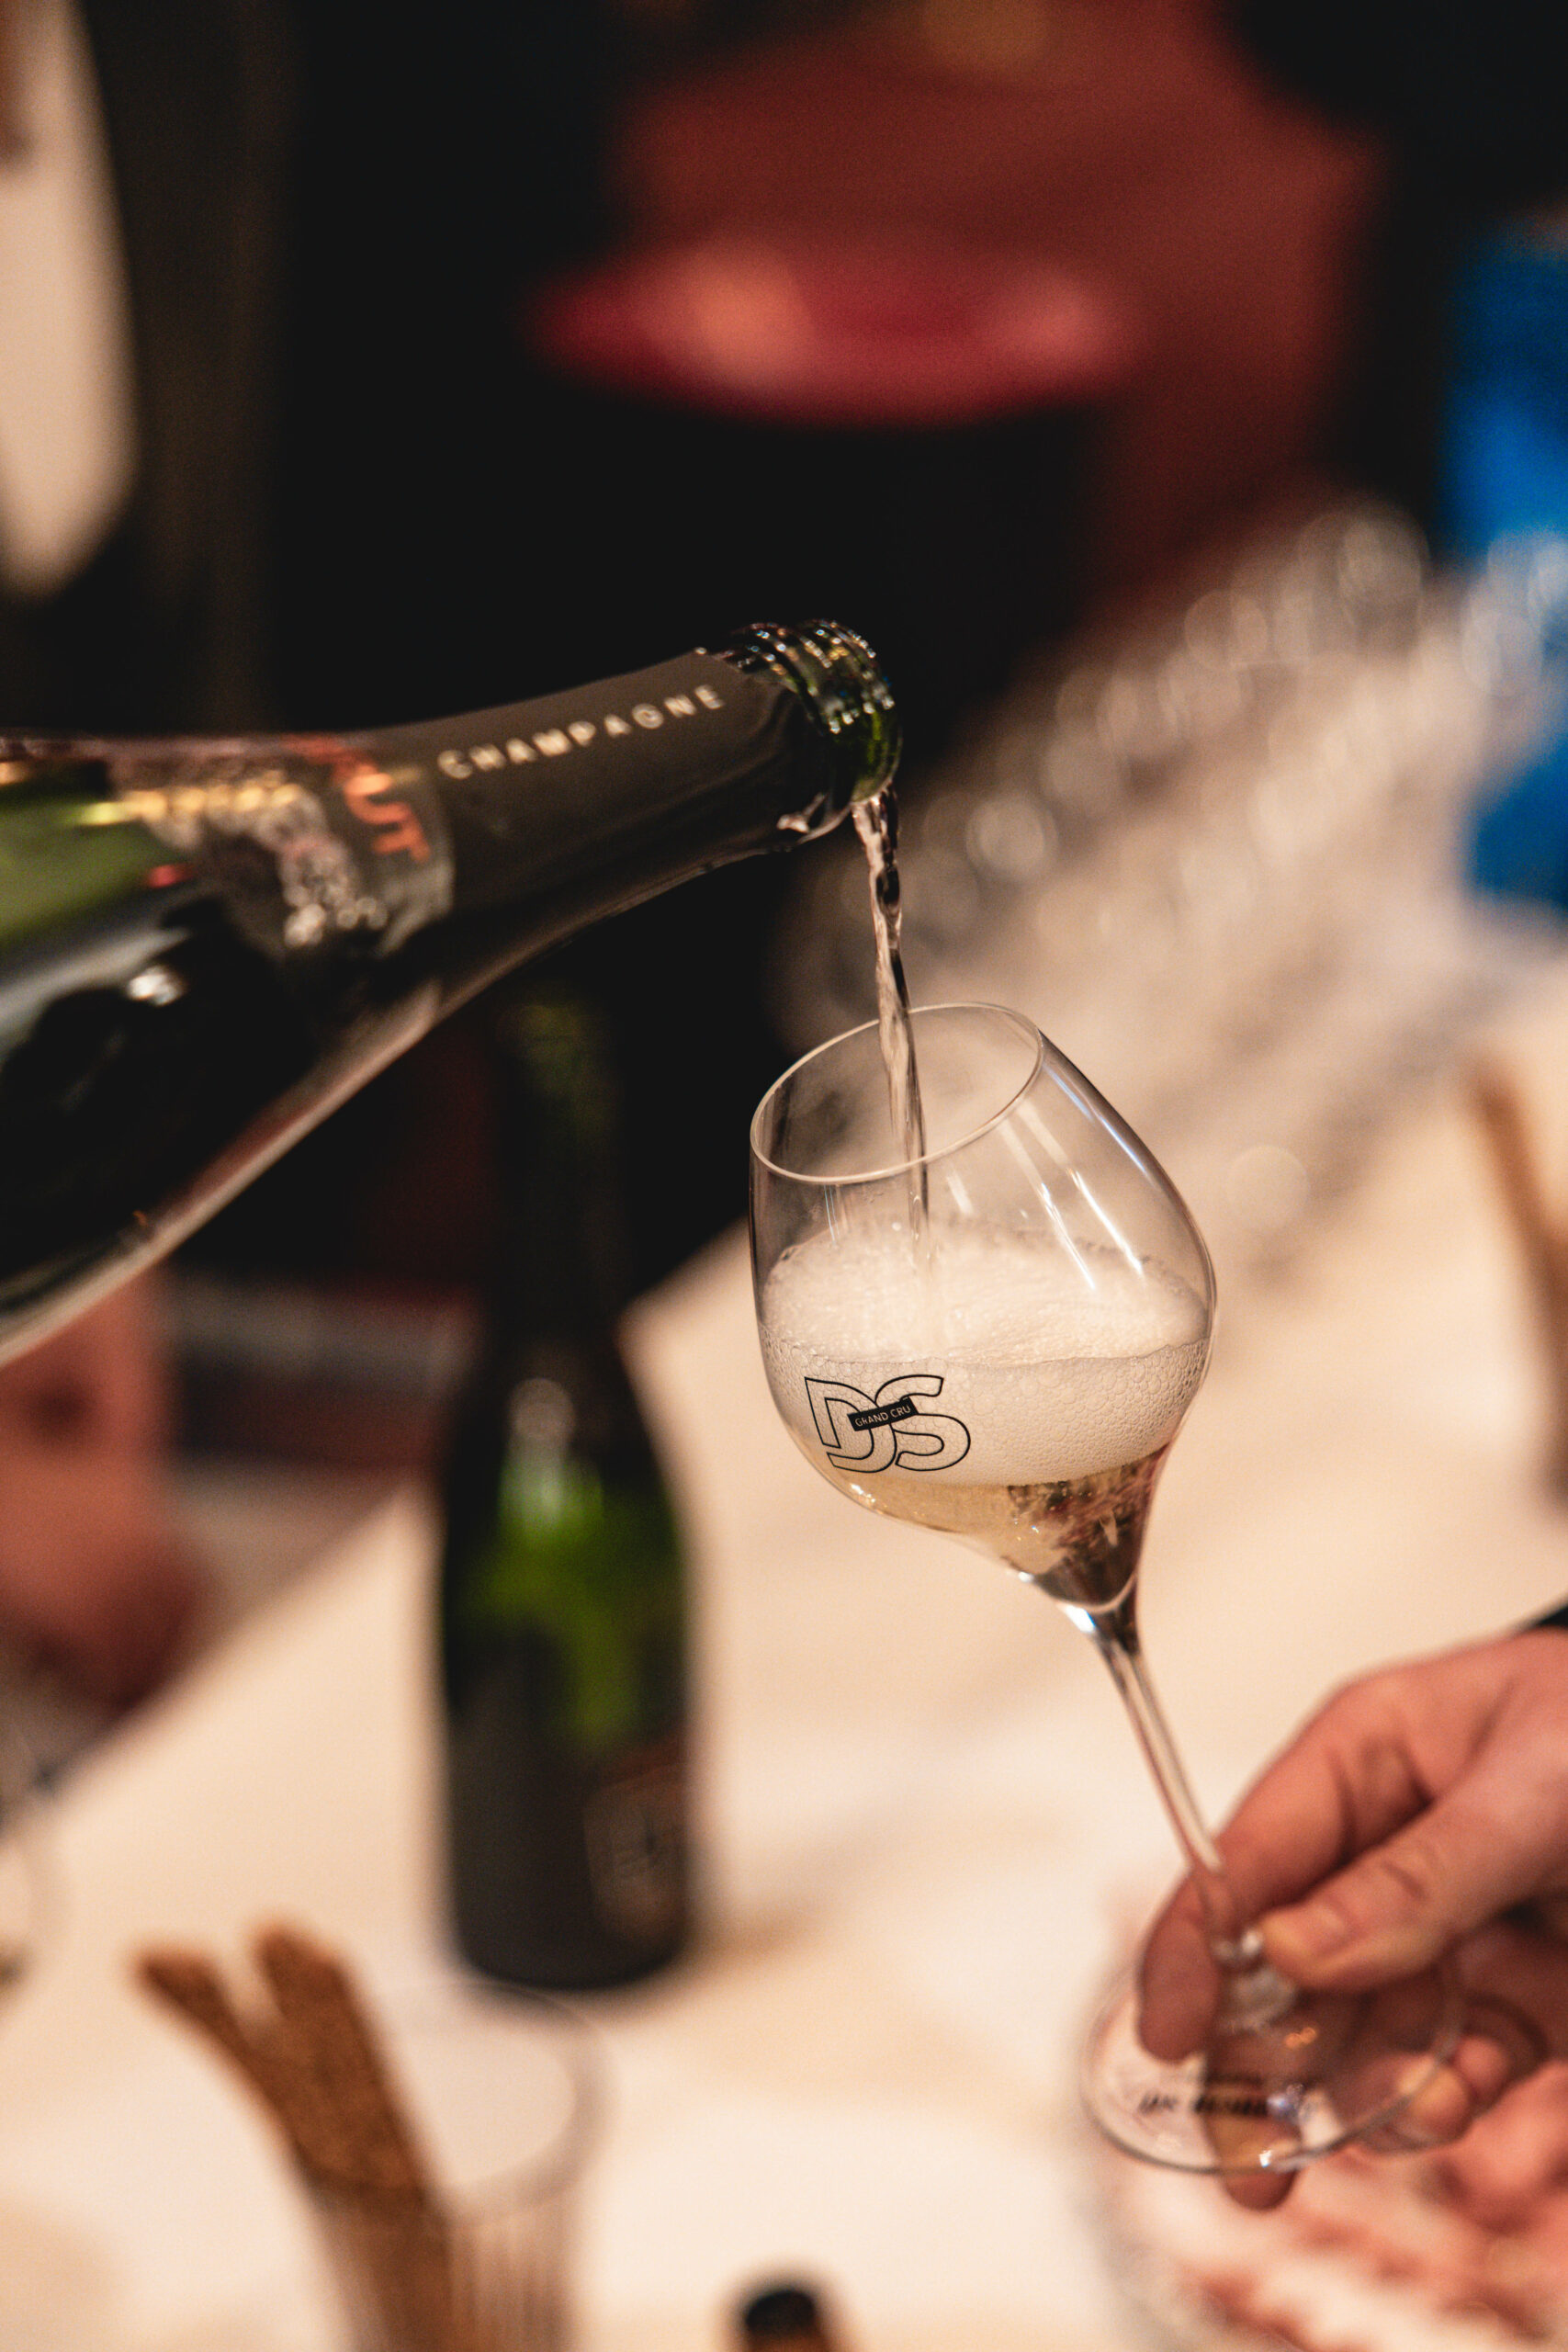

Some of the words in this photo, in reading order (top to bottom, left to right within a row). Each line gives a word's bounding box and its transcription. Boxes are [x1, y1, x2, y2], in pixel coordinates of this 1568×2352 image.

[437, 684, 724, 779] CHAMPAGNE
[854, 1411, 889, 1427] GRAND
[890, 1404, 911, 1419] CRU
